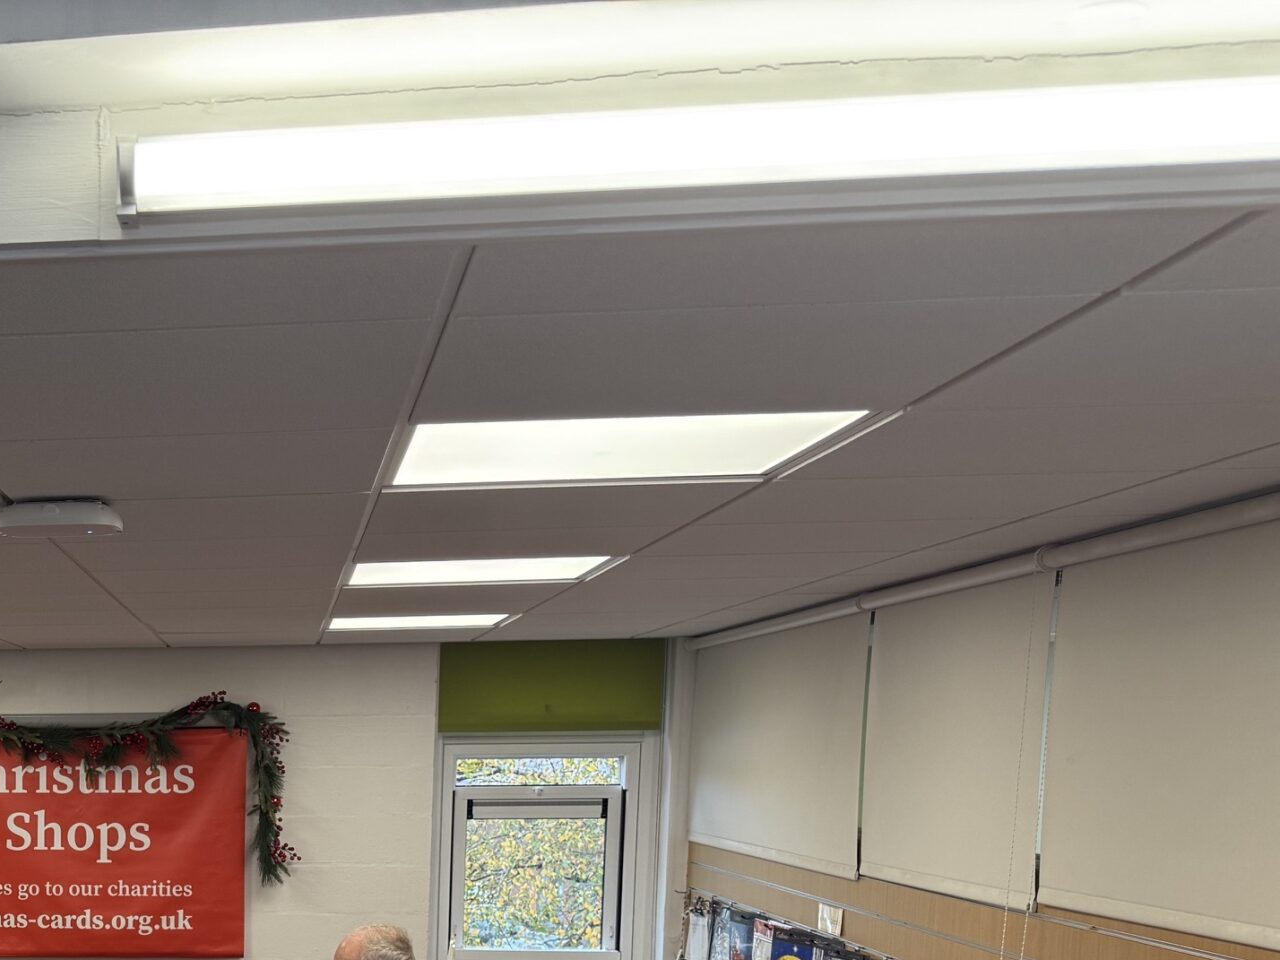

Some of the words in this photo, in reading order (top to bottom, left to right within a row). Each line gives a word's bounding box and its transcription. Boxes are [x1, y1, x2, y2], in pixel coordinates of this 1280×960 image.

[6, 809, 151, 863] Shops
[18, 882, 39, 899] go
[45, 880, 62, 896] to
[69, 883, 102, 896] our
[107, 880, 193, 897] charities
